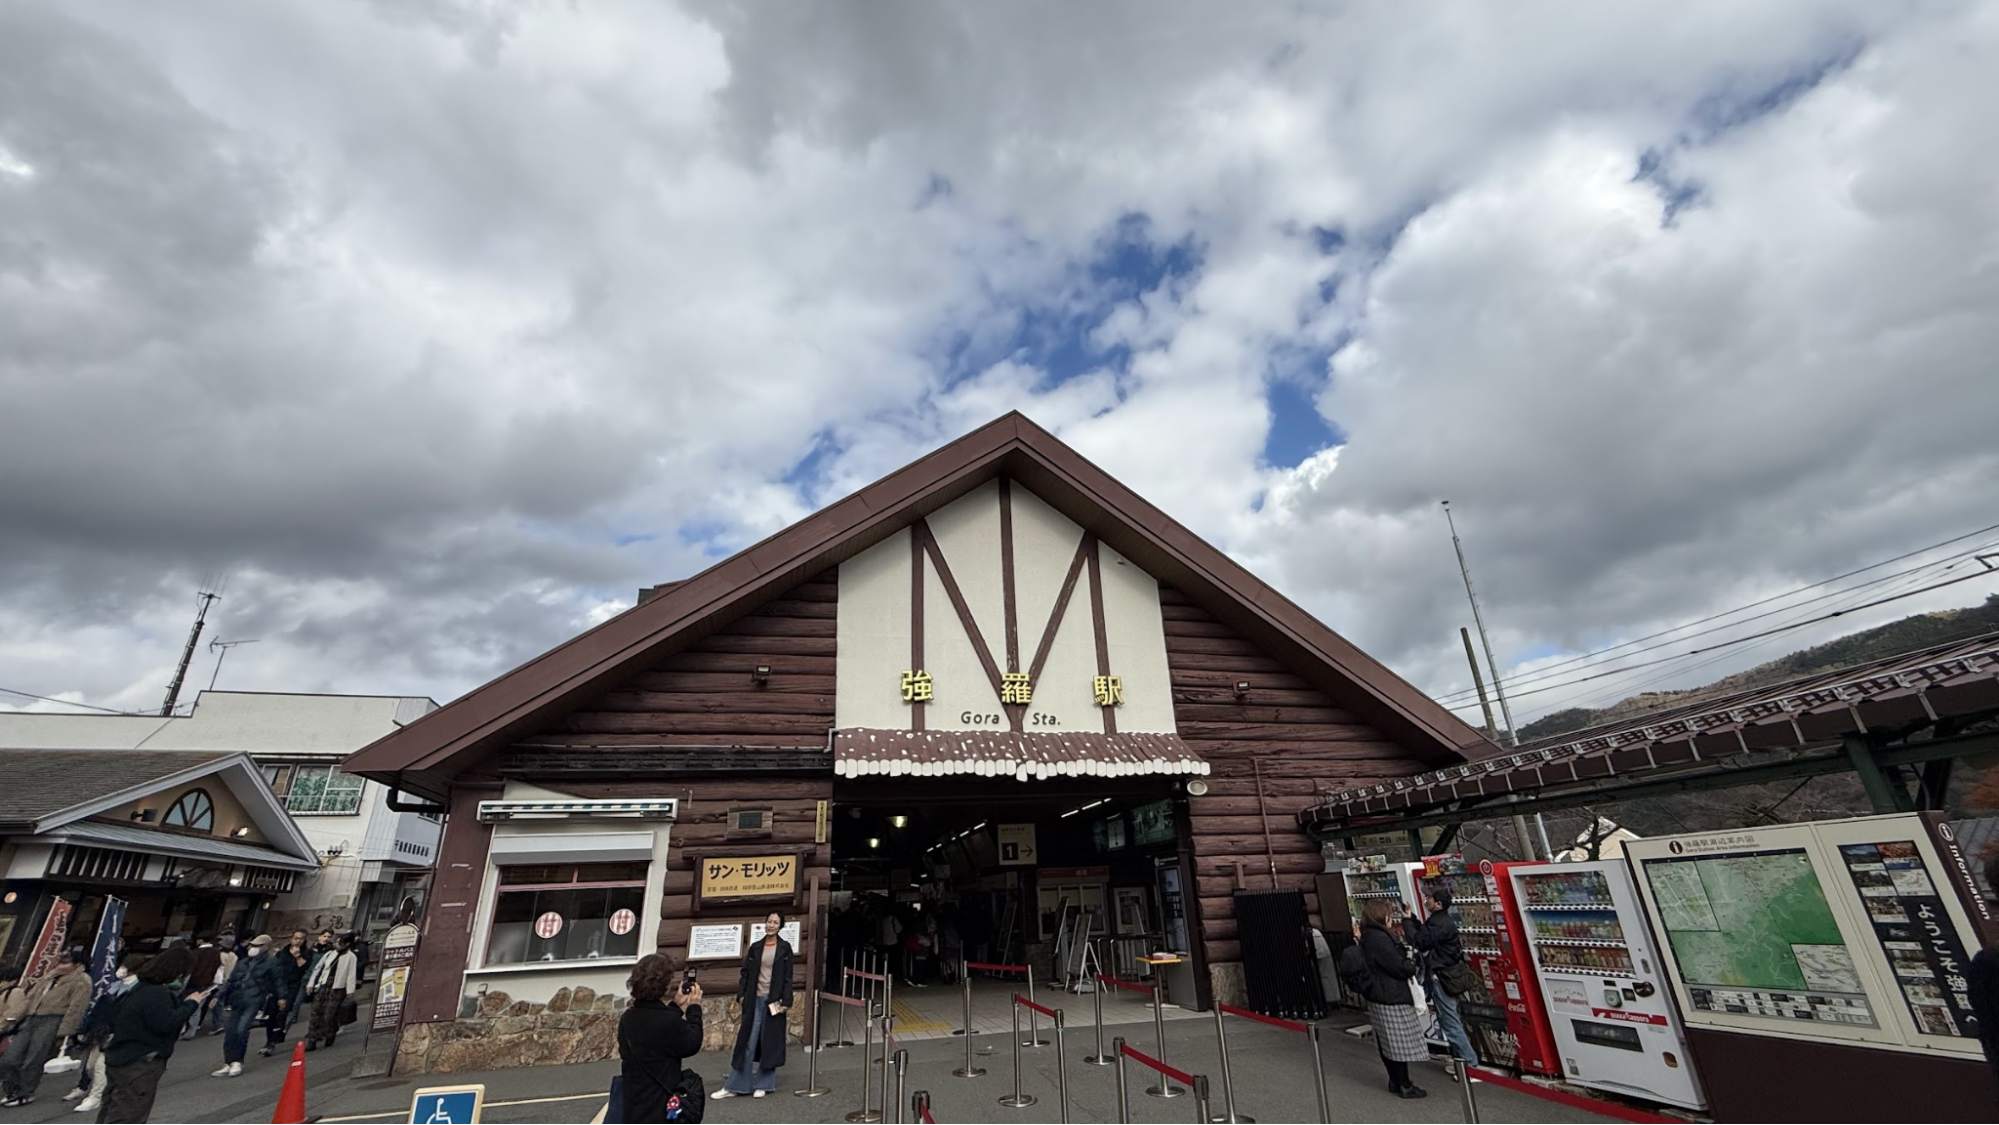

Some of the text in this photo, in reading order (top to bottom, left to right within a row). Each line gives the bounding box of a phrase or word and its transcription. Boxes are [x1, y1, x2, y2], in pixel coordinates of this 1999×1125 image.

[902, 670, 1125, 706] 強羅駅
[961, 711, 1061, 726] Gora Sta.
[1006, 845, 1013, 858] 1
[708, 861, 790, 880] サン・モリッツ
[1949, 844, 1990, 920] Information
